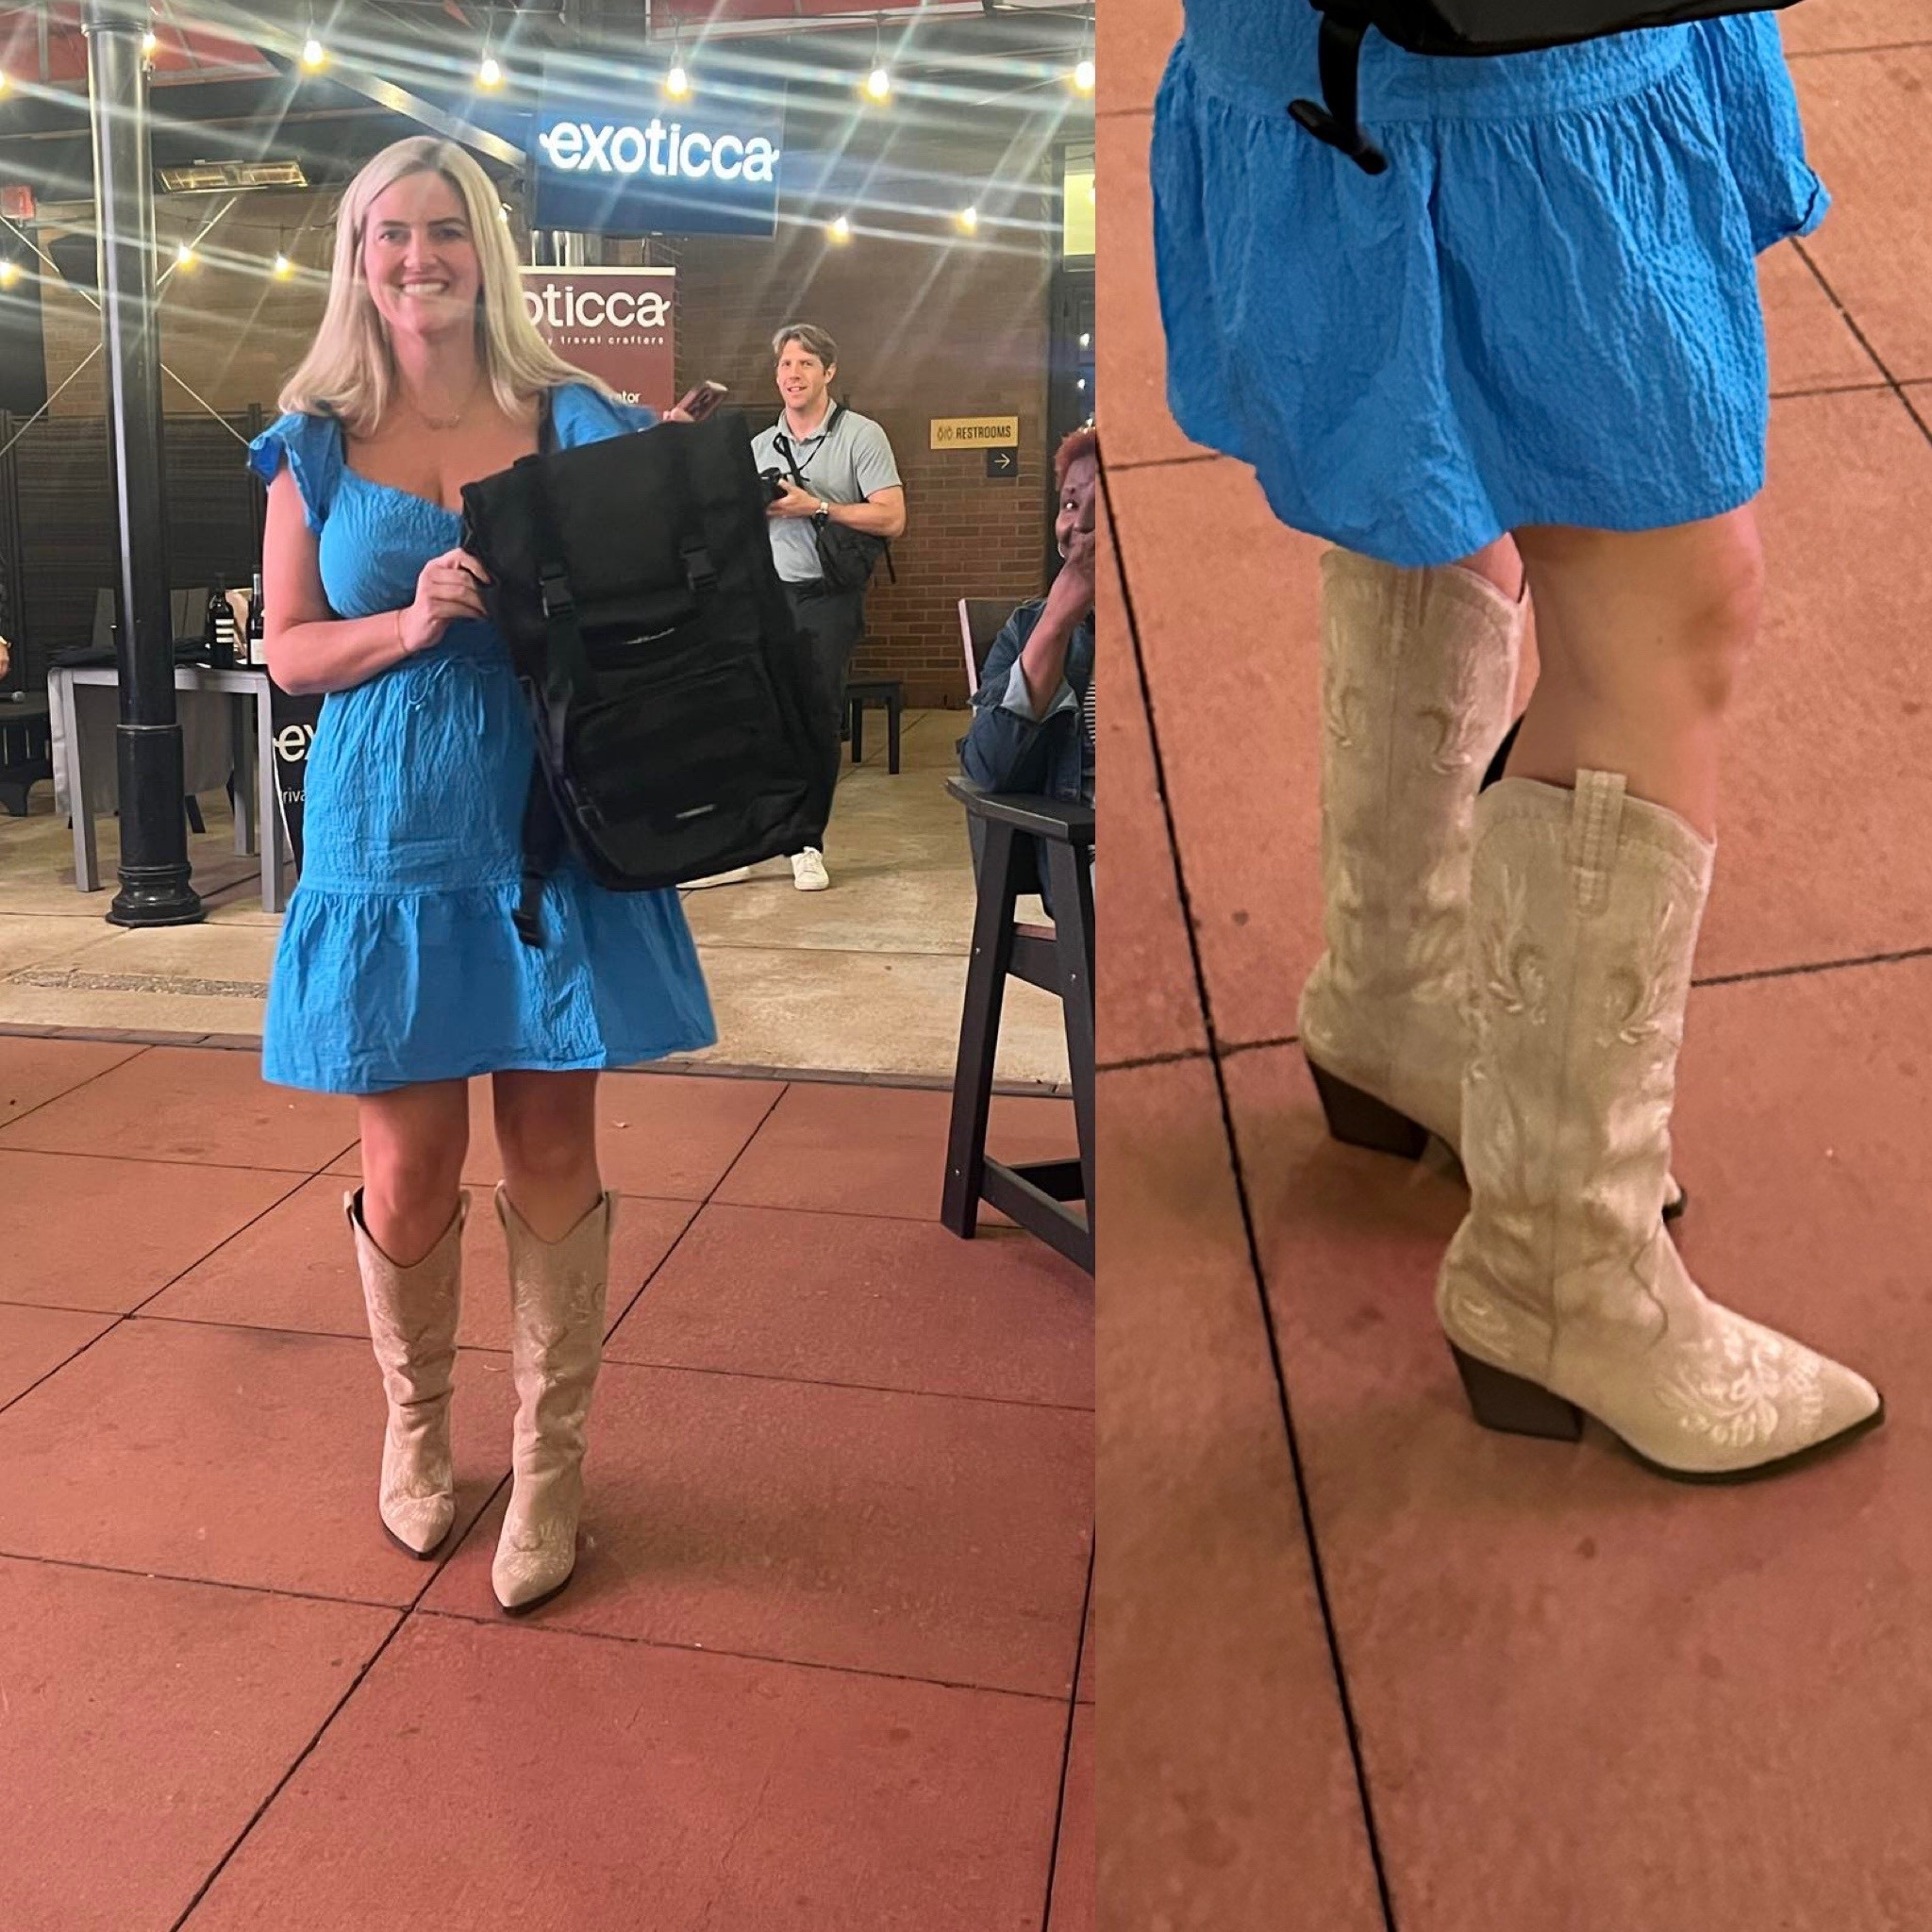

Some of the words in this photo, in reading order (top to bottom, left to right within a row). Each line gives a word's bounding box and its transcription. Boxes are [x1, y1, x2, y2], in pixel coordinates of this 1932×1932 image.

[539, 118, 780, 182] exoticca
[560, 335, 602, 345] travel
[608, 335, 664, 345] crafters
[956, 425, 1011, 440] RESTROOMS
